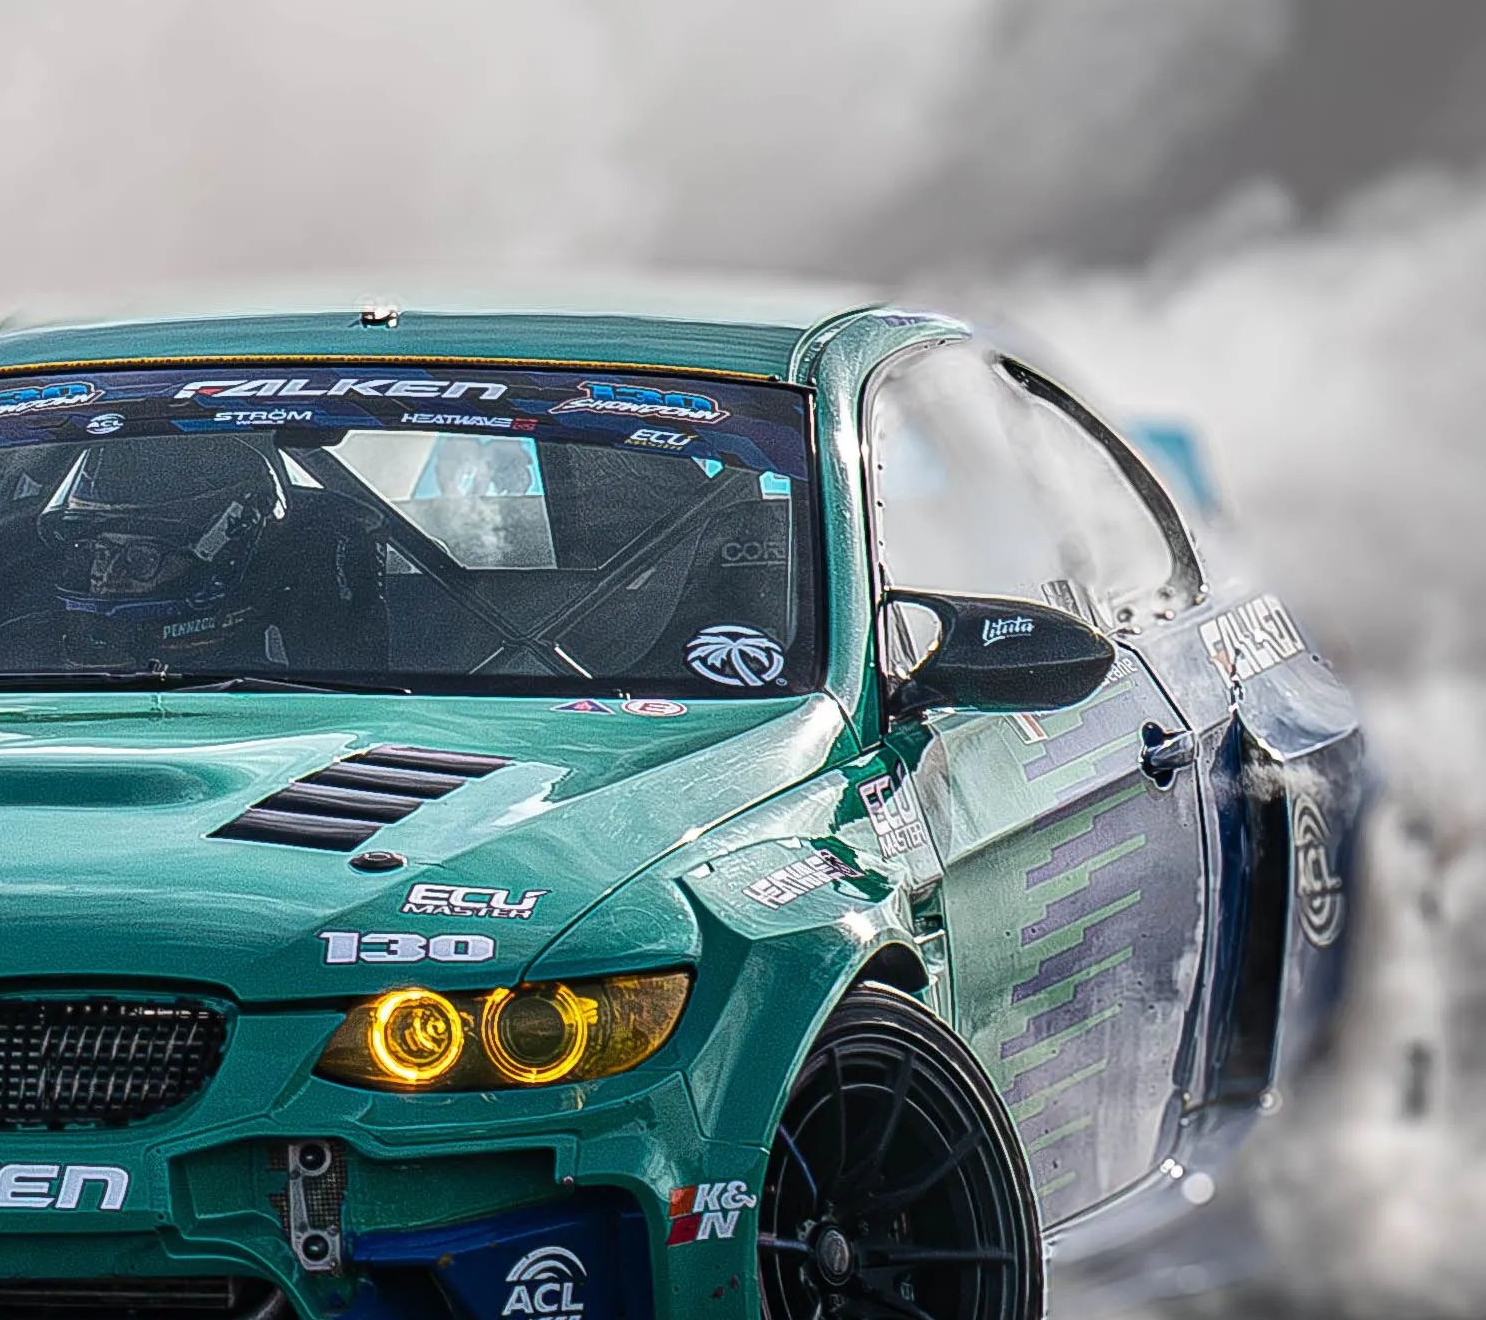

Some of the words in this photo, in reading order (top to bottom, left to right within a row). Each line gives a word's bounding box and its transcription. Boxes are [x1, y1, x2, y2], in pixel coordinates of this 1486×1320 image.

[173, 378, 509, 400] FALKEN
[213, 409, 313, 421] STRÖM
[401, 412, 513, 428] HEATWAVE
[560, 398, 722, 421] SHOWDOWN
[629, 428, 695, 446] ECU
[407, 883, 552, 910] ECU
[401, 903, 532, 919] MASTER
[317, 931, 496, 963] 130
[501, 1281, 584, 1316] ACL
